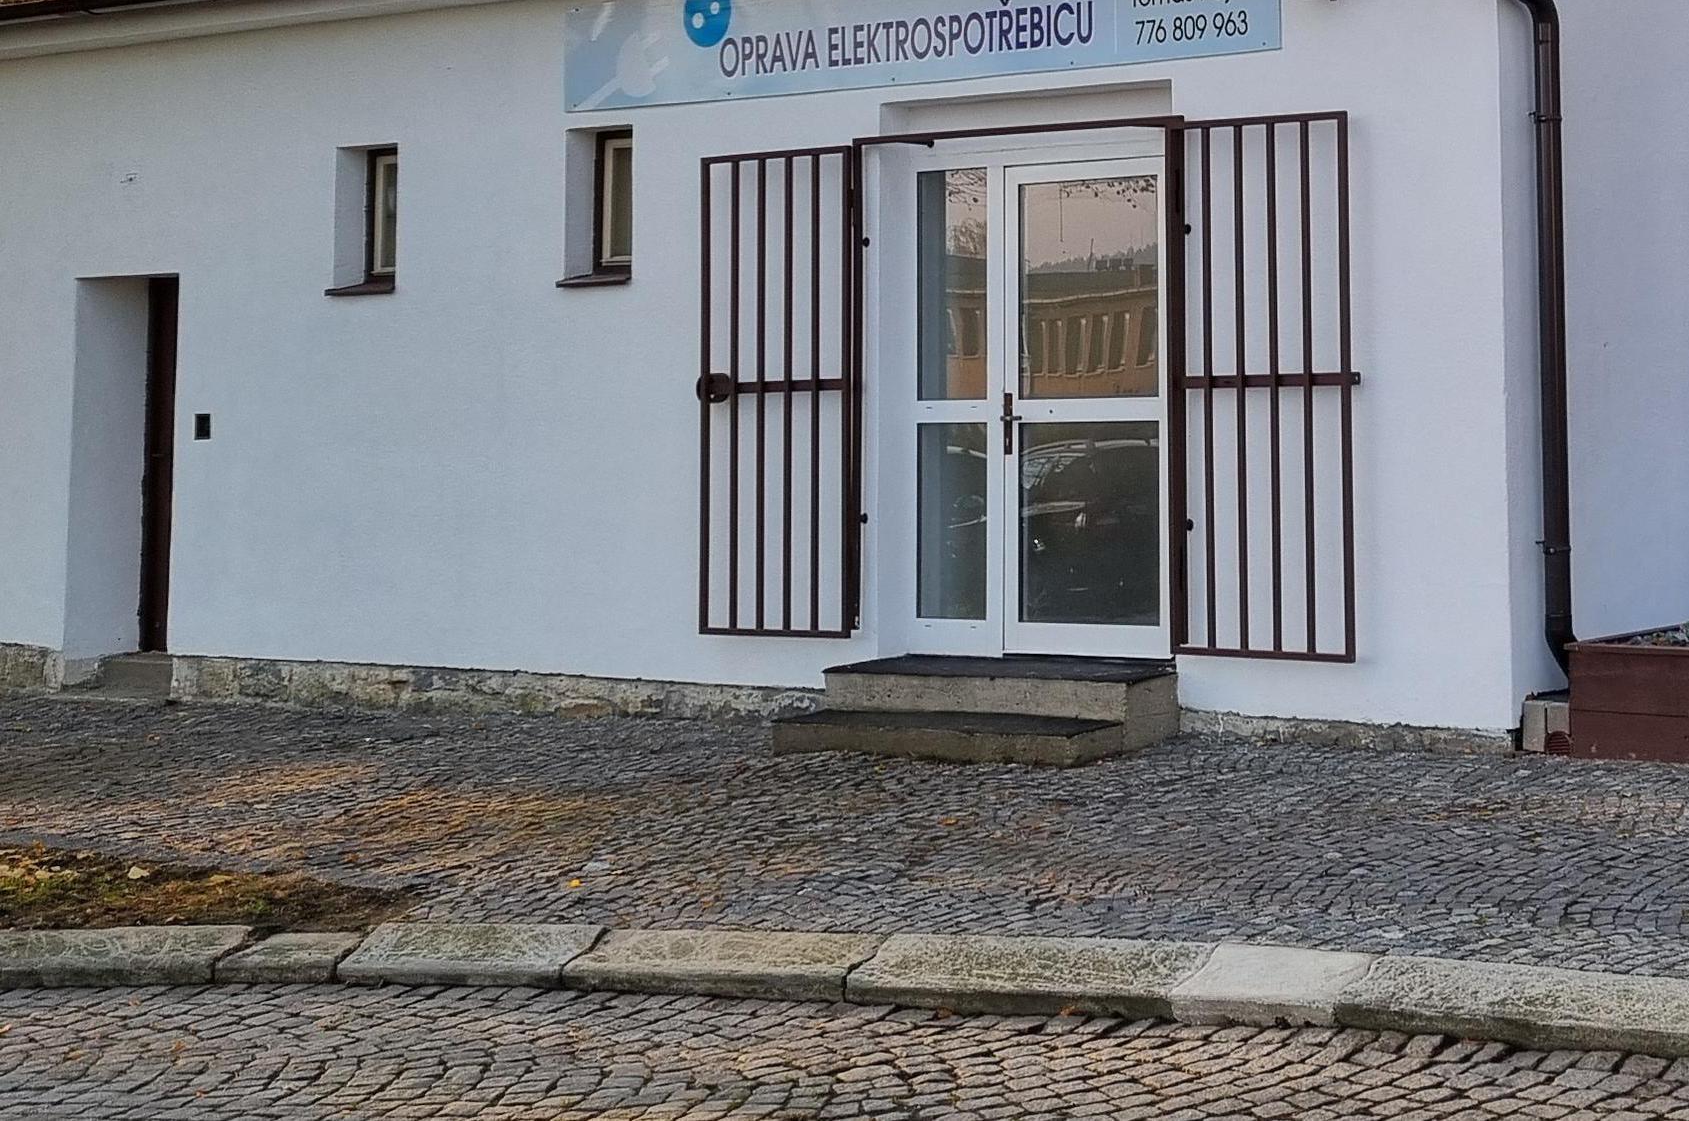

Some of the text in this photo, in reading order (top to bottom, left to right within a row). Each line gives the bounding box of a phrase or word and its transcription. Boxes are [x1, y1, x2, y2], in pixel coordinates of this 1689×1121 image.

[1135, 10, 1248, 45] 776 809 963
[720, 29, 820, 78] OPRAVA
